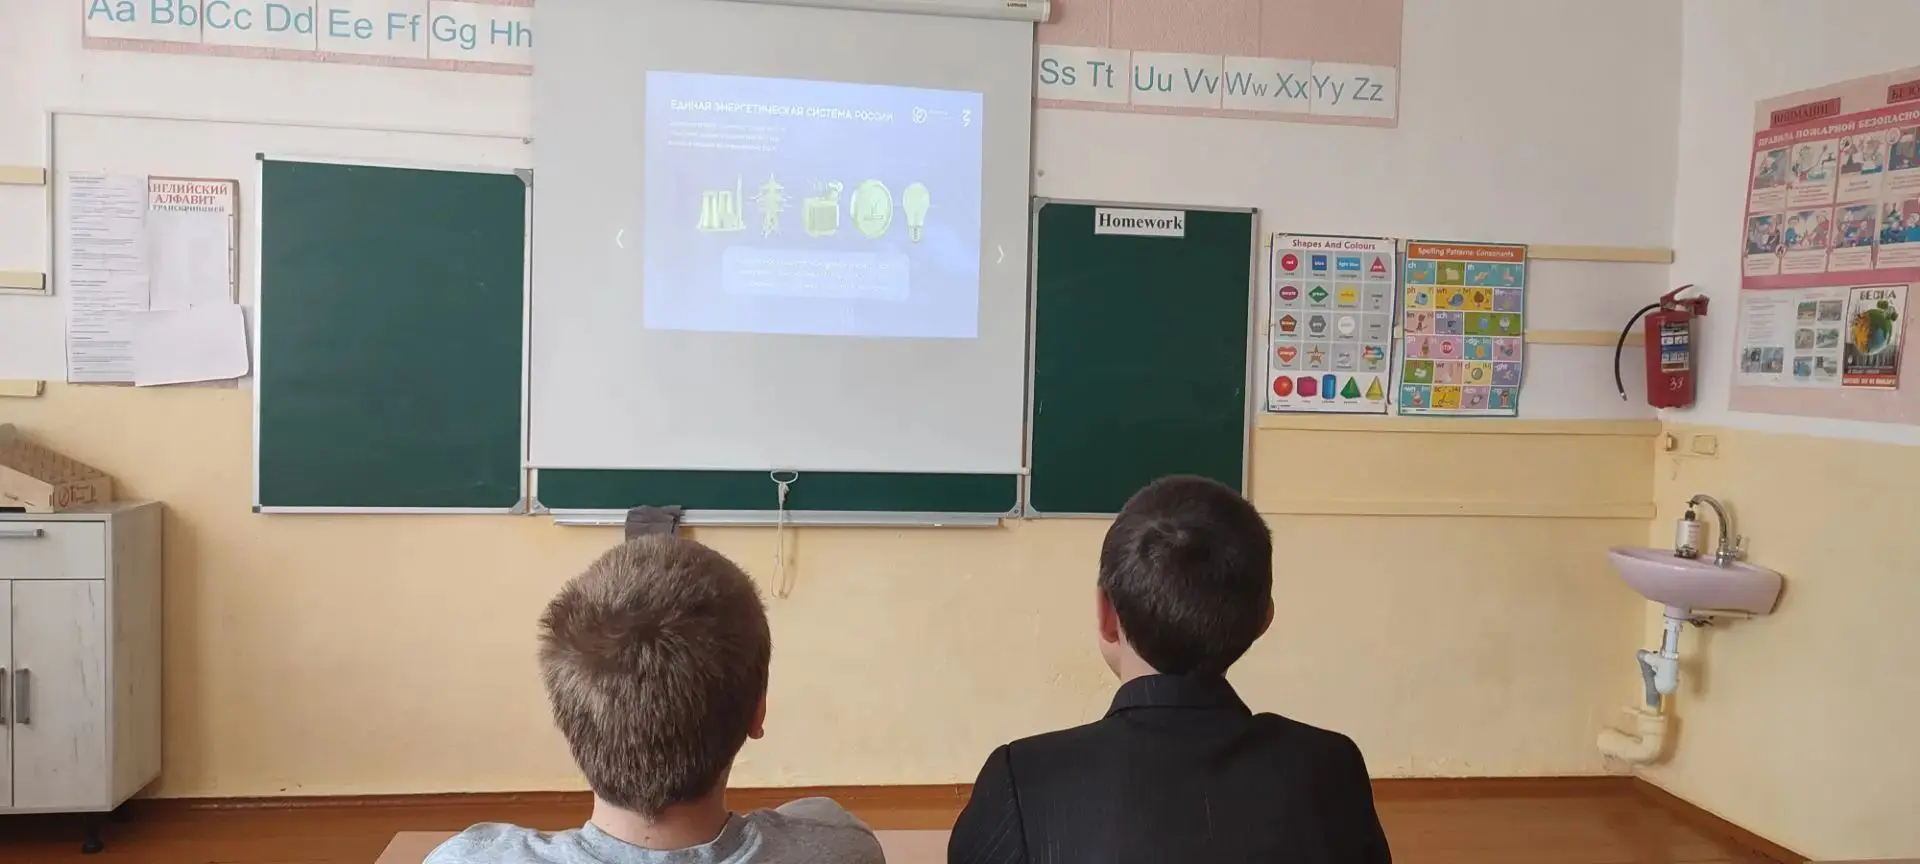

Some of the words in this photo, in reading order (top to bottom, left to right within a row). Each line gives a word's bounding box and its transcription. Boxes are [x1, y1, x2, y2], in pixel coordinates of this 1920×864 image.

[87, 0, 135, 22] Aa
[150, 0, 198, 26] Bb
[206, 0, 252, 30] Cc
[266, 3, 313, 34] Dd
[328, 8, 373, 39] Ee
[387, 12, 421, 42] Ff
[432, 15, 476, 50] Gg
[490, 19, 533, 48] Hh
[1039, 58, 1076, 86] Ss
[1086, 60, 1115, 88] Tt
[1134, 64, 1173, 92] Uu
[1183, 67, 1220, 94] Vv
[1224, 71, 1268, 97] Ww
[1273, 72, 1309, 100] Xx
[1312, 75, 1345, 106] Yy
[1352, 76, 1385, 102] Zz
[670, 99, 711, 111] ЕДИНАЯ
[714, 102, 802, 116] ЭНЕРГЕТИЧЕСКАЯ
[806, 107, 852, 120] СИСТЕМА
[855, 109, 894, 122] РОССИИ
[1758, 132, 1794, 147] ПРАВИЛА
[1795, 121, 1856, 139] ПОЖАРНОЙ
[155, 194, 216, 205] АЛФАВИТ
[1098, 212, 1183, 230] Homework
[1291, 239, 1322, 249] Shapes
[1324, 240, 1342, 249] And
[1344, 241, 1376, 251] Colours
[1418, 247, 1445, 257] Spelling
